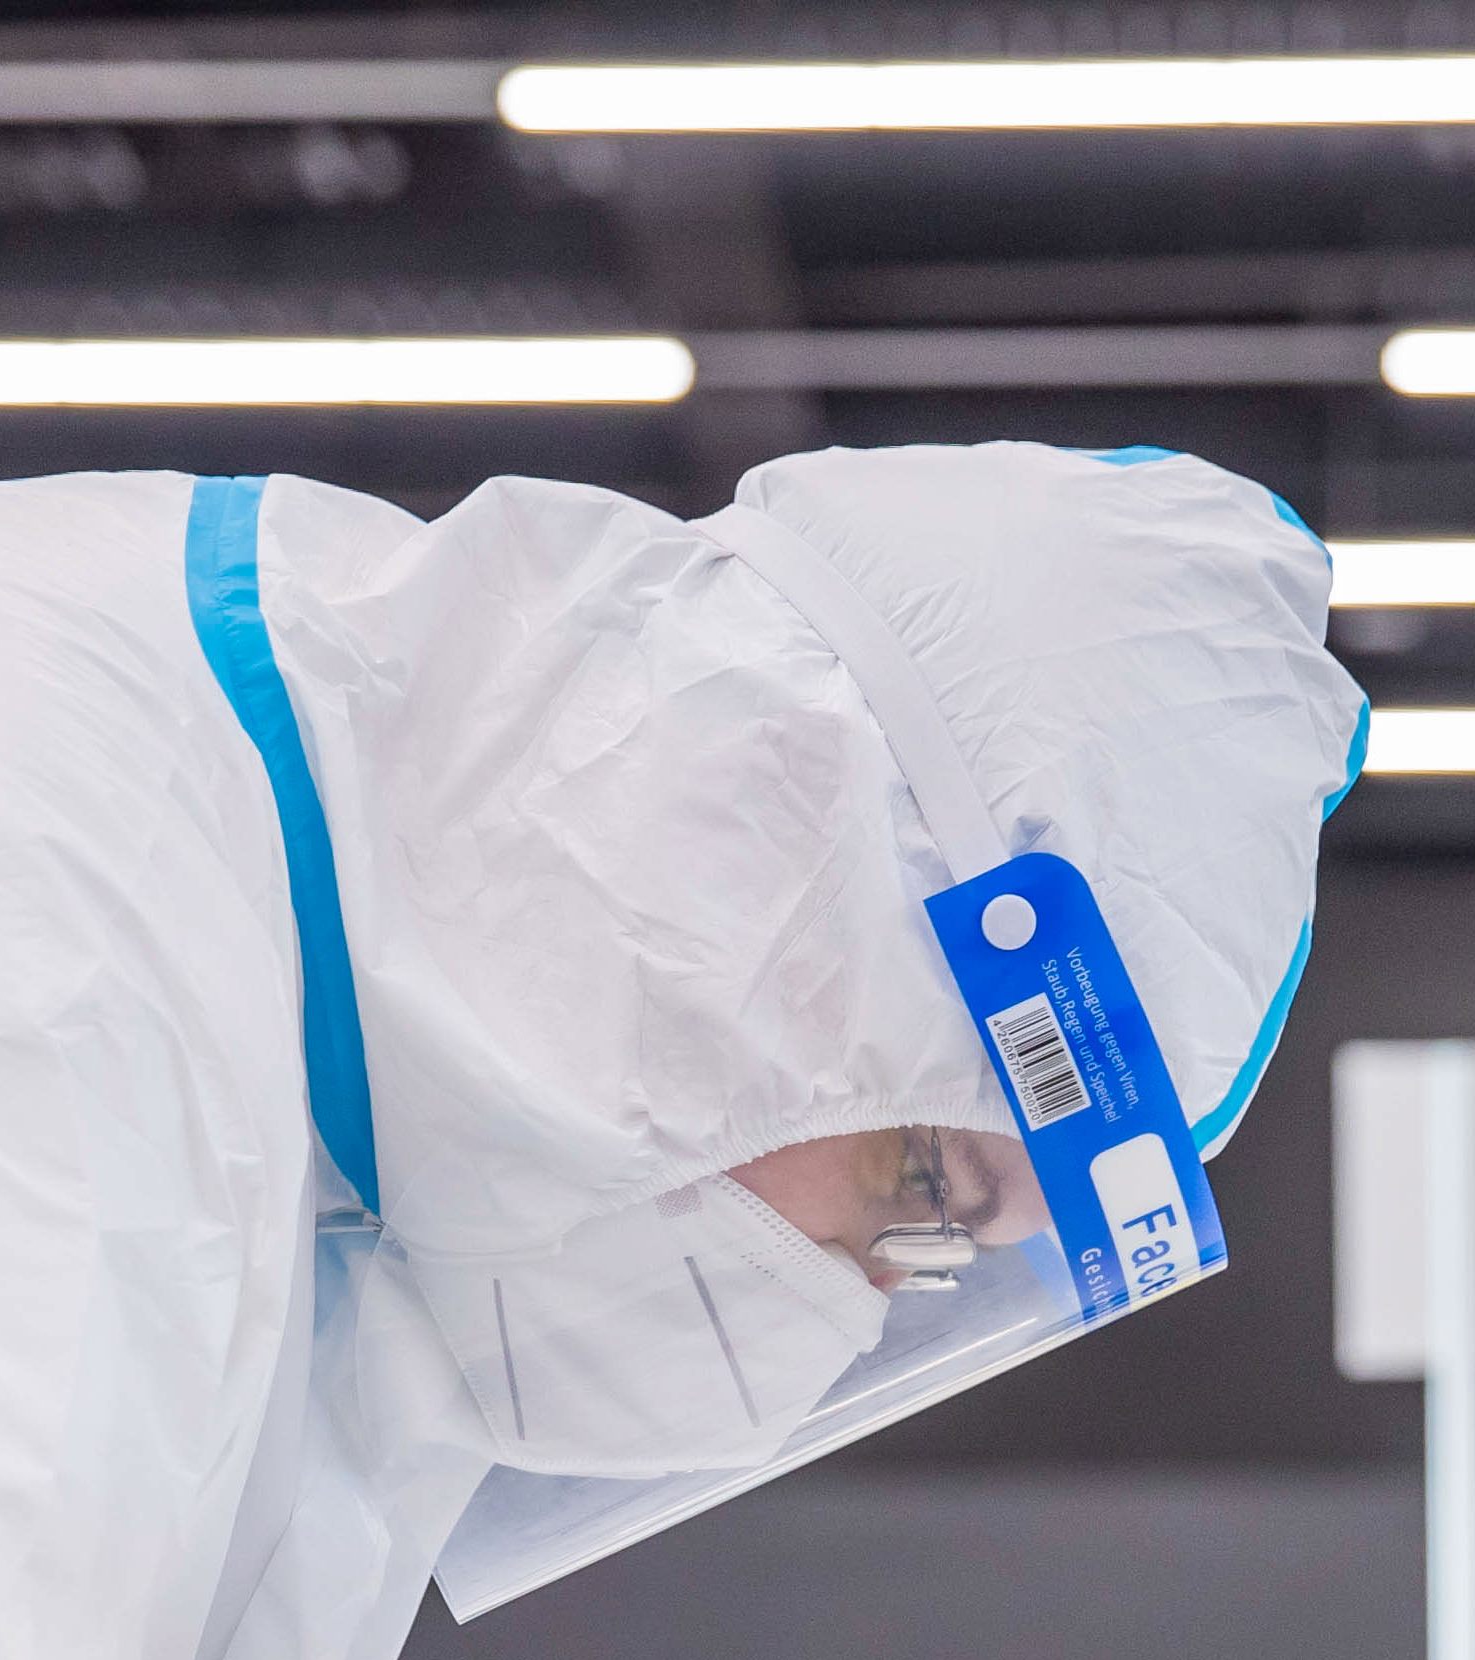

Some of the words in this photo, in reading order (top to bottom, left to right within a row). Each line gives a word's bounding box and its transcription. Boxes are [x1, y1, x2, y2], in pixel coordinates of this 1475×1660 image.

[1066, 946, 1110, 1032] Vorbeugung
[1098, 1031, 1126, 1072] gegen
[1119, 1070, 1141, 1110] Viren,
[1079, 1045, 1101, 1072] und
[1090, 1071, 1122, 1124] Speichel
